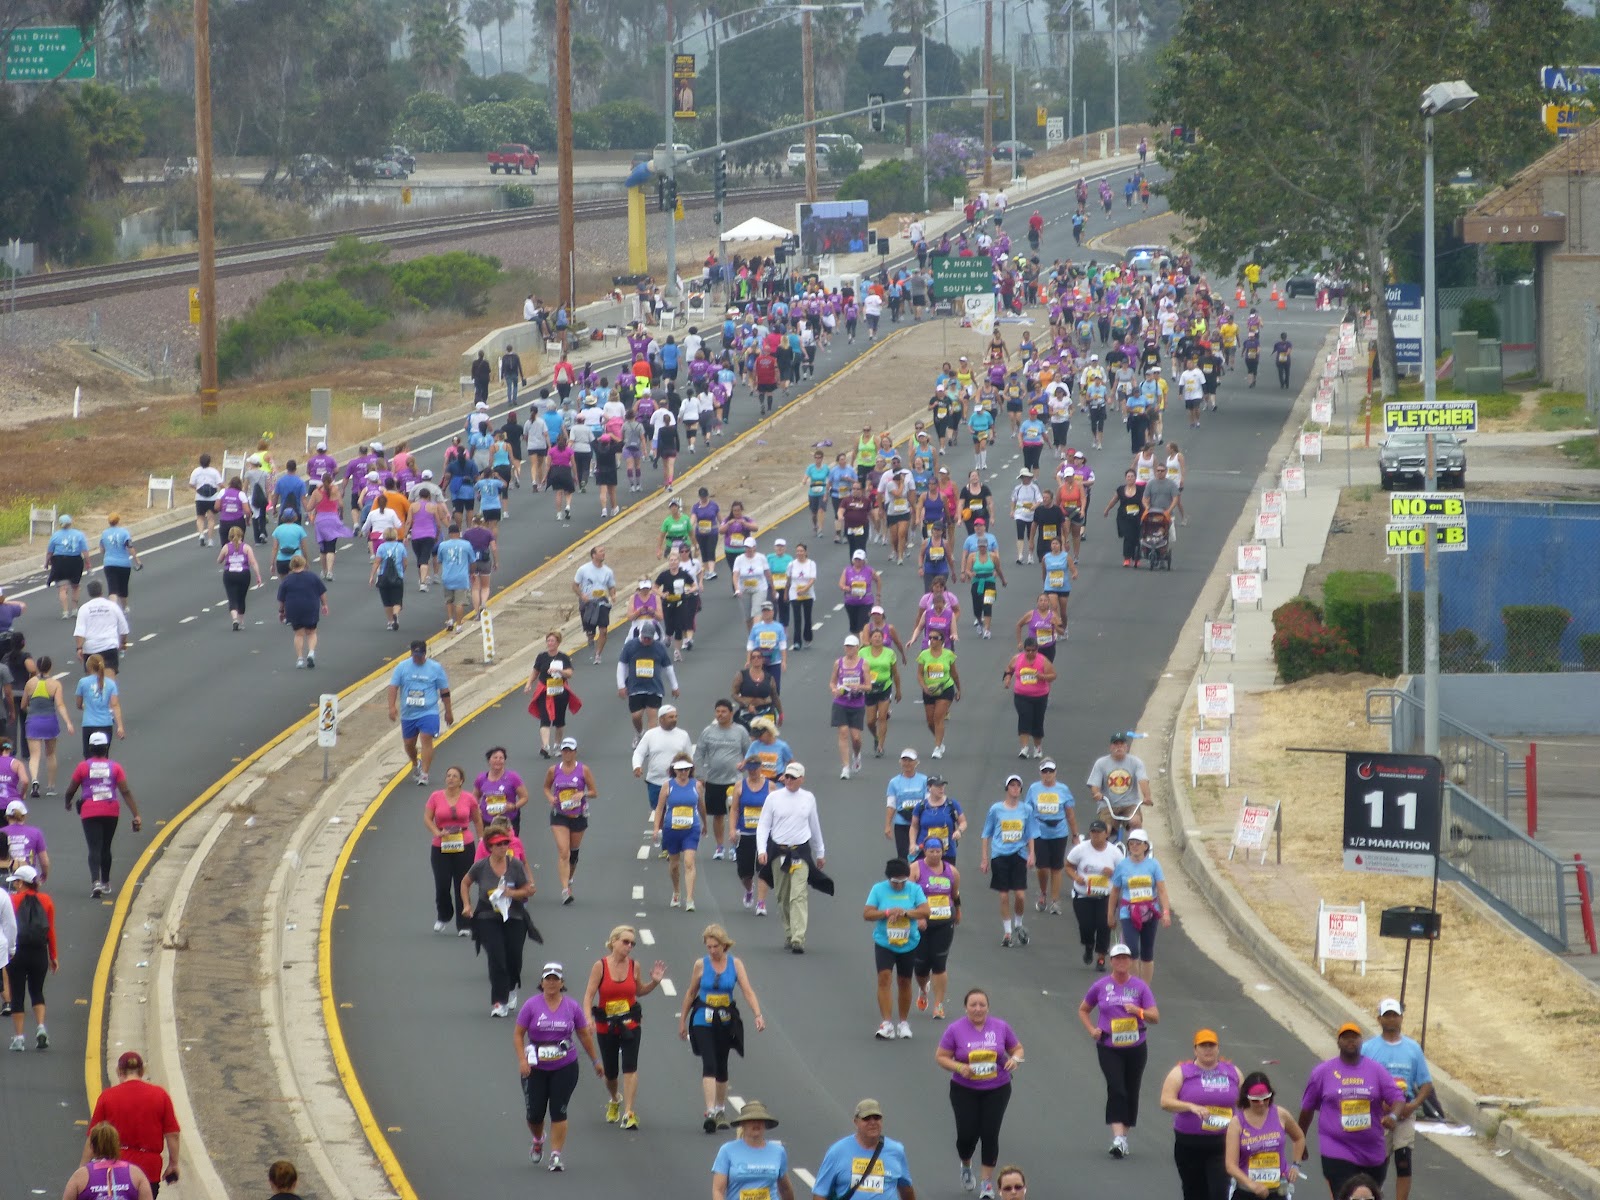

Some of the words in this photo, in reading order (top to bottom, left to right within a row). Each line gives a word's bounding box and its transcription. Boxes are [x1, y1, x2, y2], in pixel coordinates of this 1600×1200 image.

[33, 33, 59, 41] Drive
[14, 44, 33, 53] Bay
[39, 44, 66, 52] Drive
[11, 67, 49, 75] Avenue
[1048, 129, 1062, 138] 65
[937, 271, 967, 279] Morena
[1387, 409, 1474, 427] FLETCHER
[1393, 499, 1427, 515] NO
[1429, 503, 1442, 511] on
[1444, 499, 1463, 515] B
[1389, 529, 1426, 546] NO
[1446, 527, 1464, 544] B
[1207, 689, 1216, 697] NO
[1199, 743, 1210, 751] NO
[1364, 790, 1417, 829] 11
[1244, 815, 1255, 823] NO
[1350, 837, 1366, 847] 1/2
[1368, 838, 1430, 850] MARATHON
[1330, 920, 1343, 930] NO
[1329, 930, 1357, 938] PARKING
